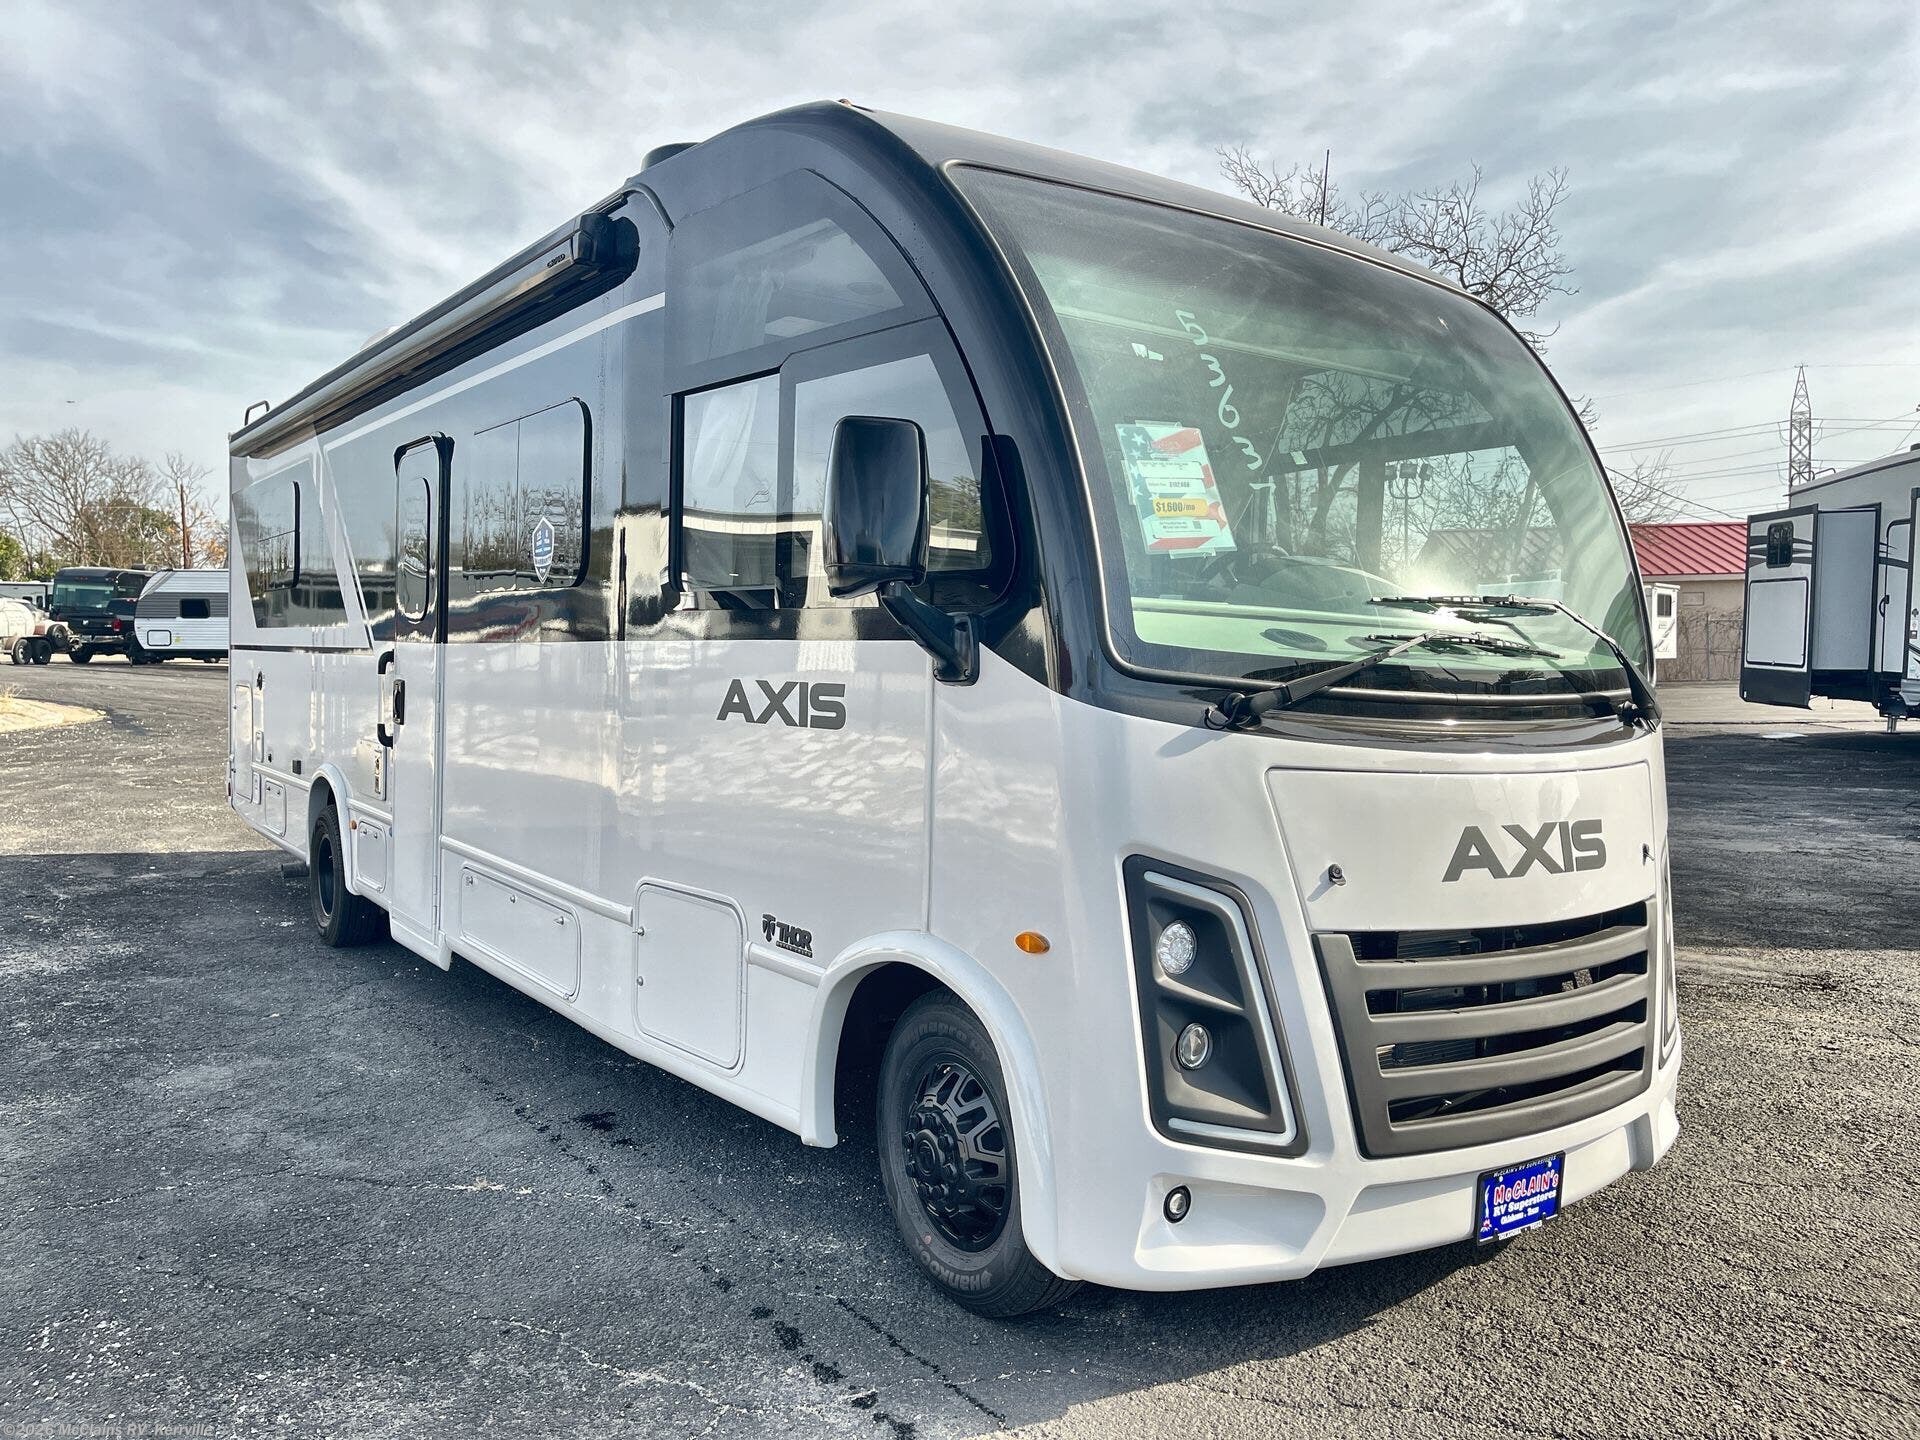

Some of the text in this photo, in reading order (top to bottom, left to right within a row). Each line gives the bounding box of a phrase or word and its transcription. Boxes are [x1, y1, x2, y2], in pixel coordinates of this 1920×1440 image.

[716, 679, 846, 730] AXIS
[1442, 819, 1606, 882] AXIS
[776, 922, 812, 951] THOR
[1494, 1169, 1559, 1205] McCLAIN's
[1493, 1202, 1507, 1217] RV
